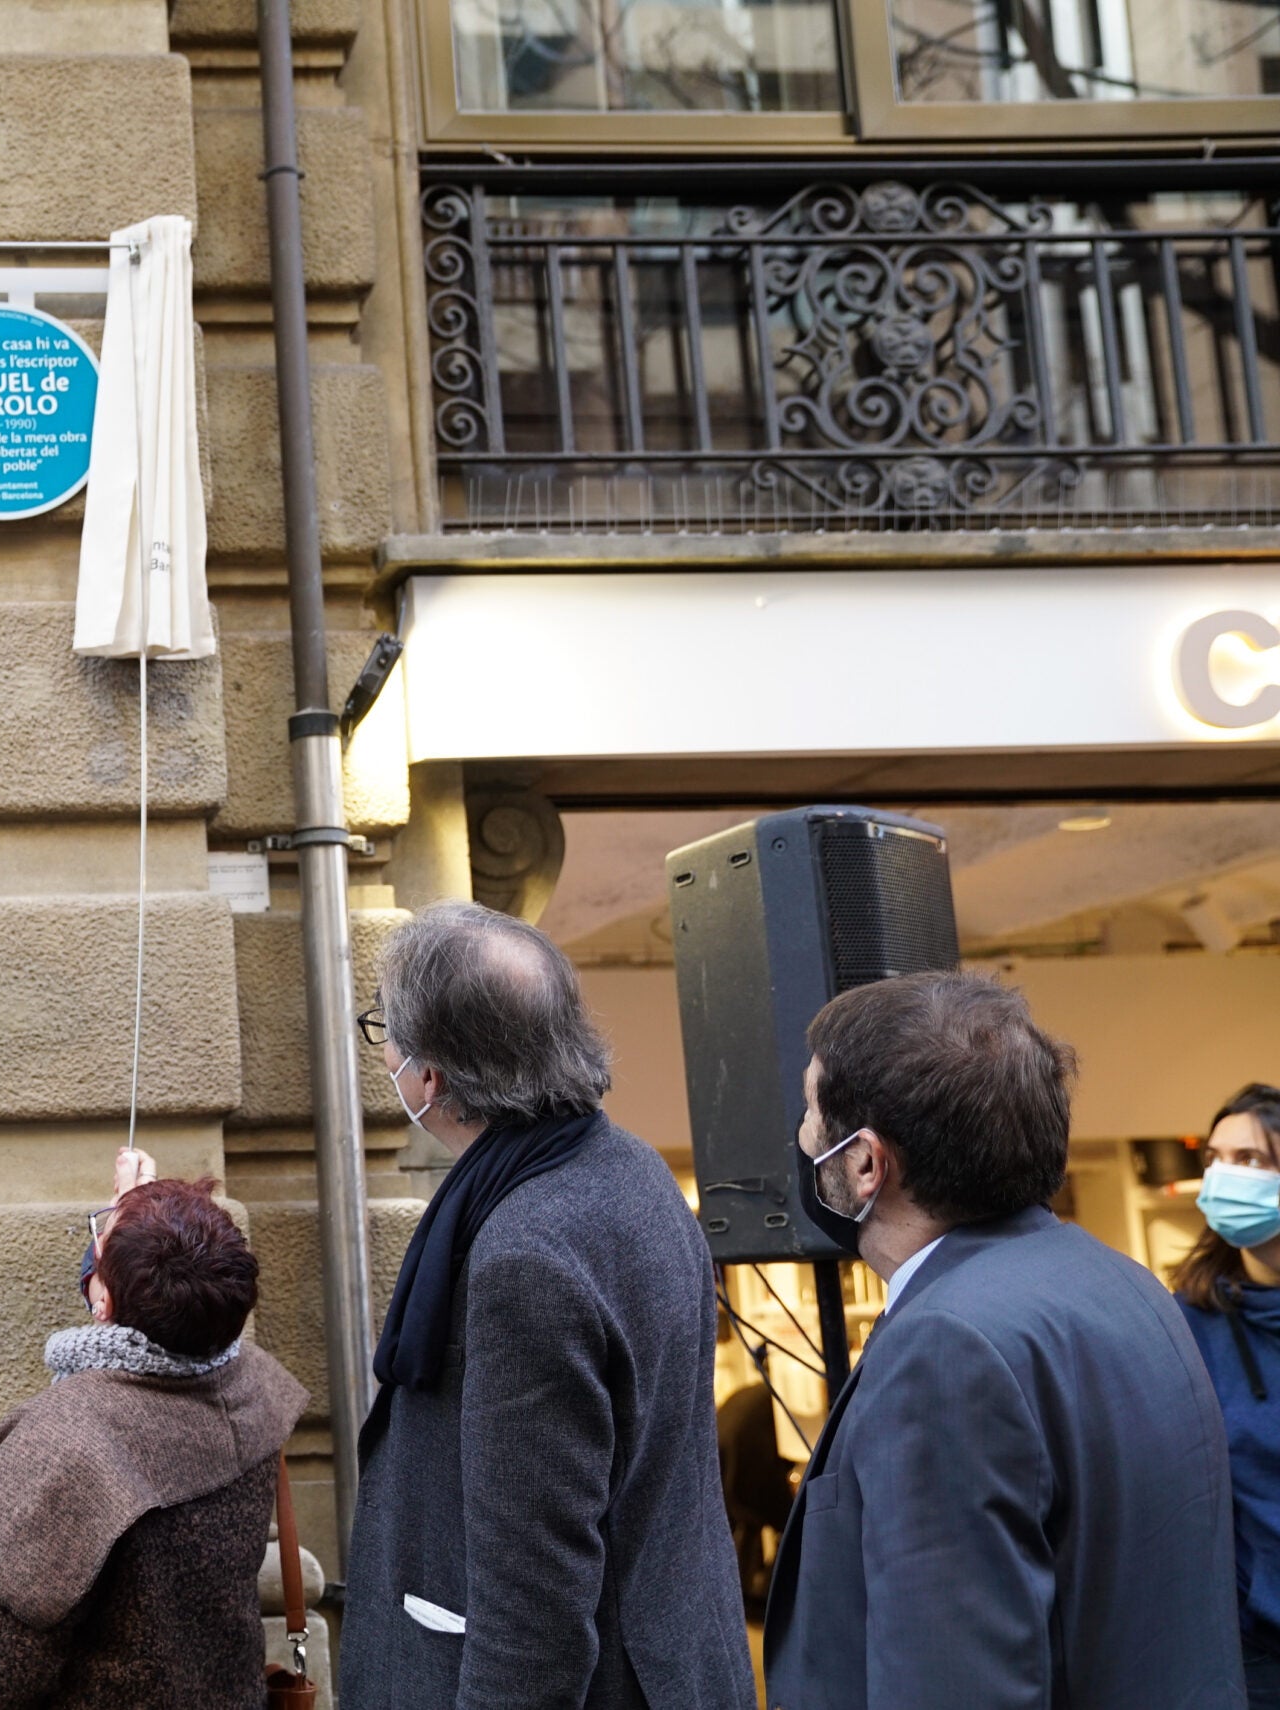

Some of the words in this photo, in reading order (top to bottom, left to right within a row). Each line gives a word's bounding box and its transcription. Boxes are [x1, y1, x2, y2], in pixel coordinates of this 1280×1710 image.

[2, 339, 32, 351] casa
[36, 336, 49, 350] hi
[53, 339, 70, 350] va
[40, 371, 70, 392] de
[11, 432, 22, 443] la
[25, 433, 57, 443] meva
[59, 431, 87, 443] obra
[40, 445, 59, 457] del
[1, 491, 44, 501] Barcelona
